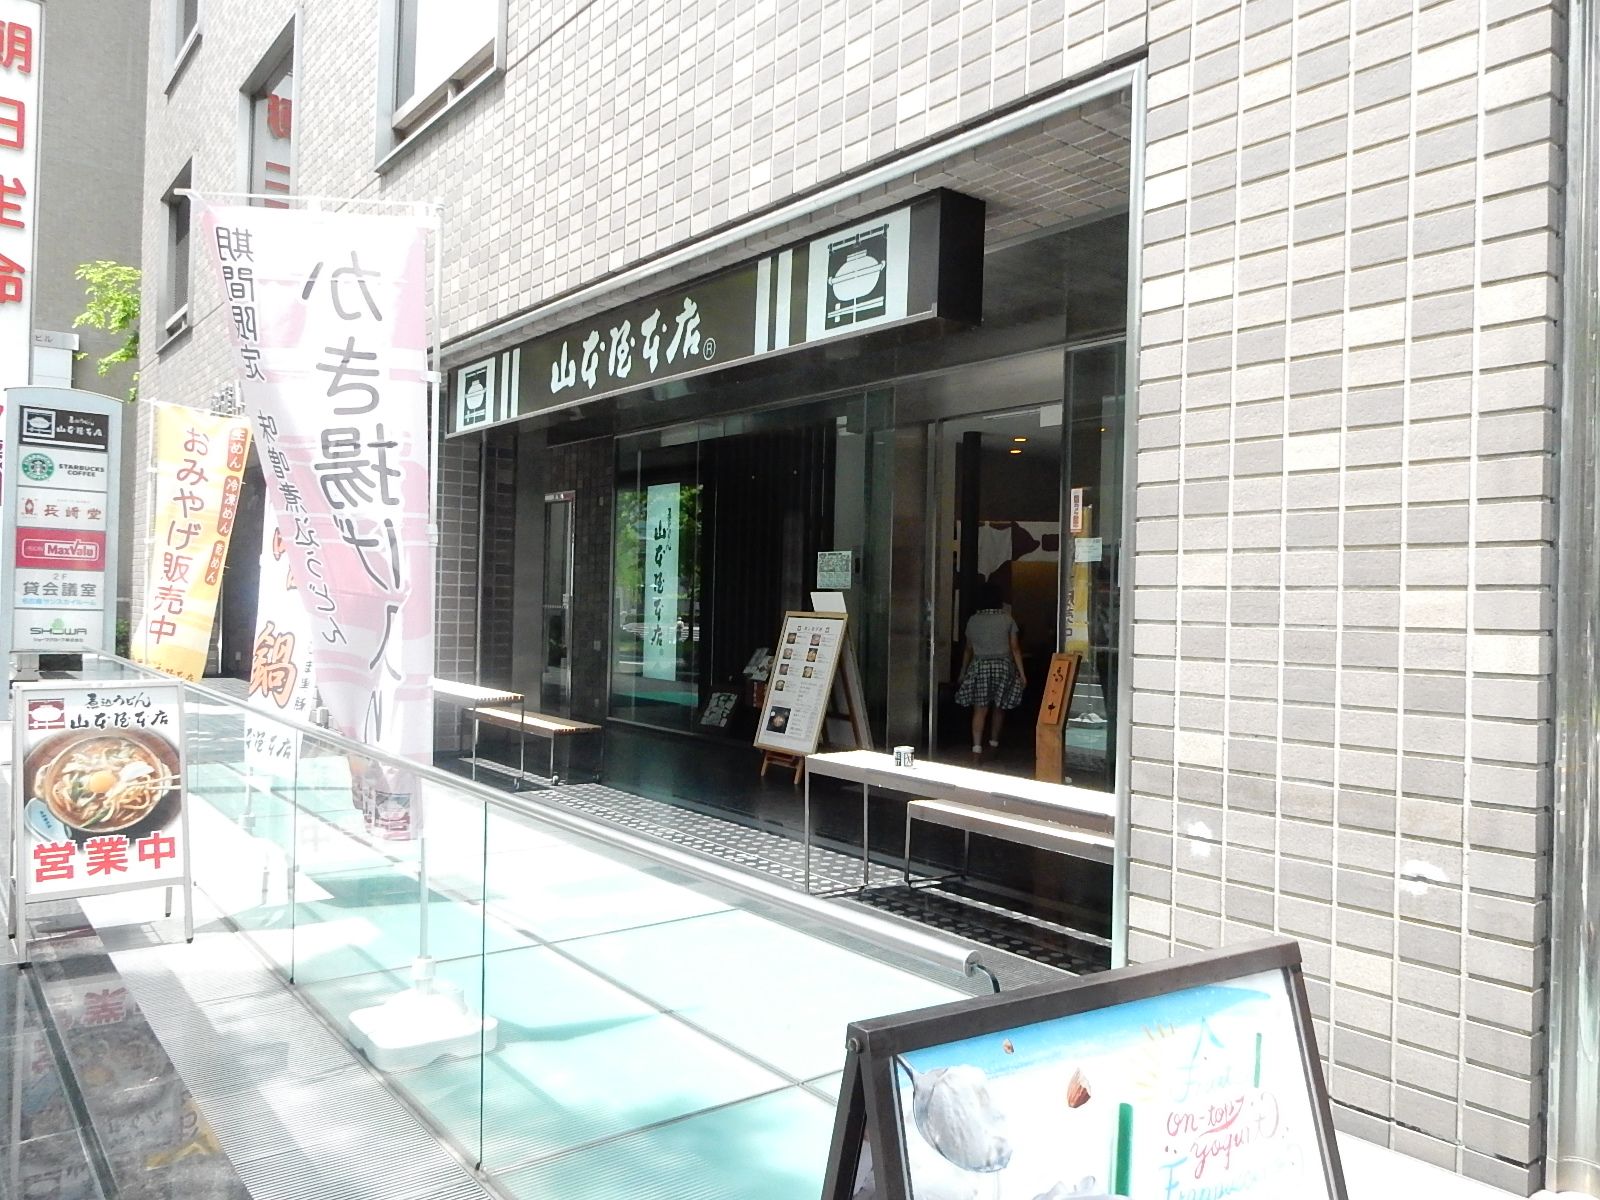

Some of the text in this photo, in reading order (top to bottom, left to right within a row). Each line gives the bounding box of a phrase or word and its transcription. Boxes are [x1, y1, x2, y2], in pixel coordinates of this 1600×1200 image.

[549, 296, 701, 395] 山本屋本店
[58, 463, 105, 473] STARBUCKS
[149, 426, 210, 645] おみやげ販売中
[47, 539, 94, 557] MaxValu
[23, 581, 97, 597] 貸会議室
[30, 627, 88, 636] SHOWA
[70, 710, 169, 730] 山本屋本店
[33, 832, 177, 883] 営業中
